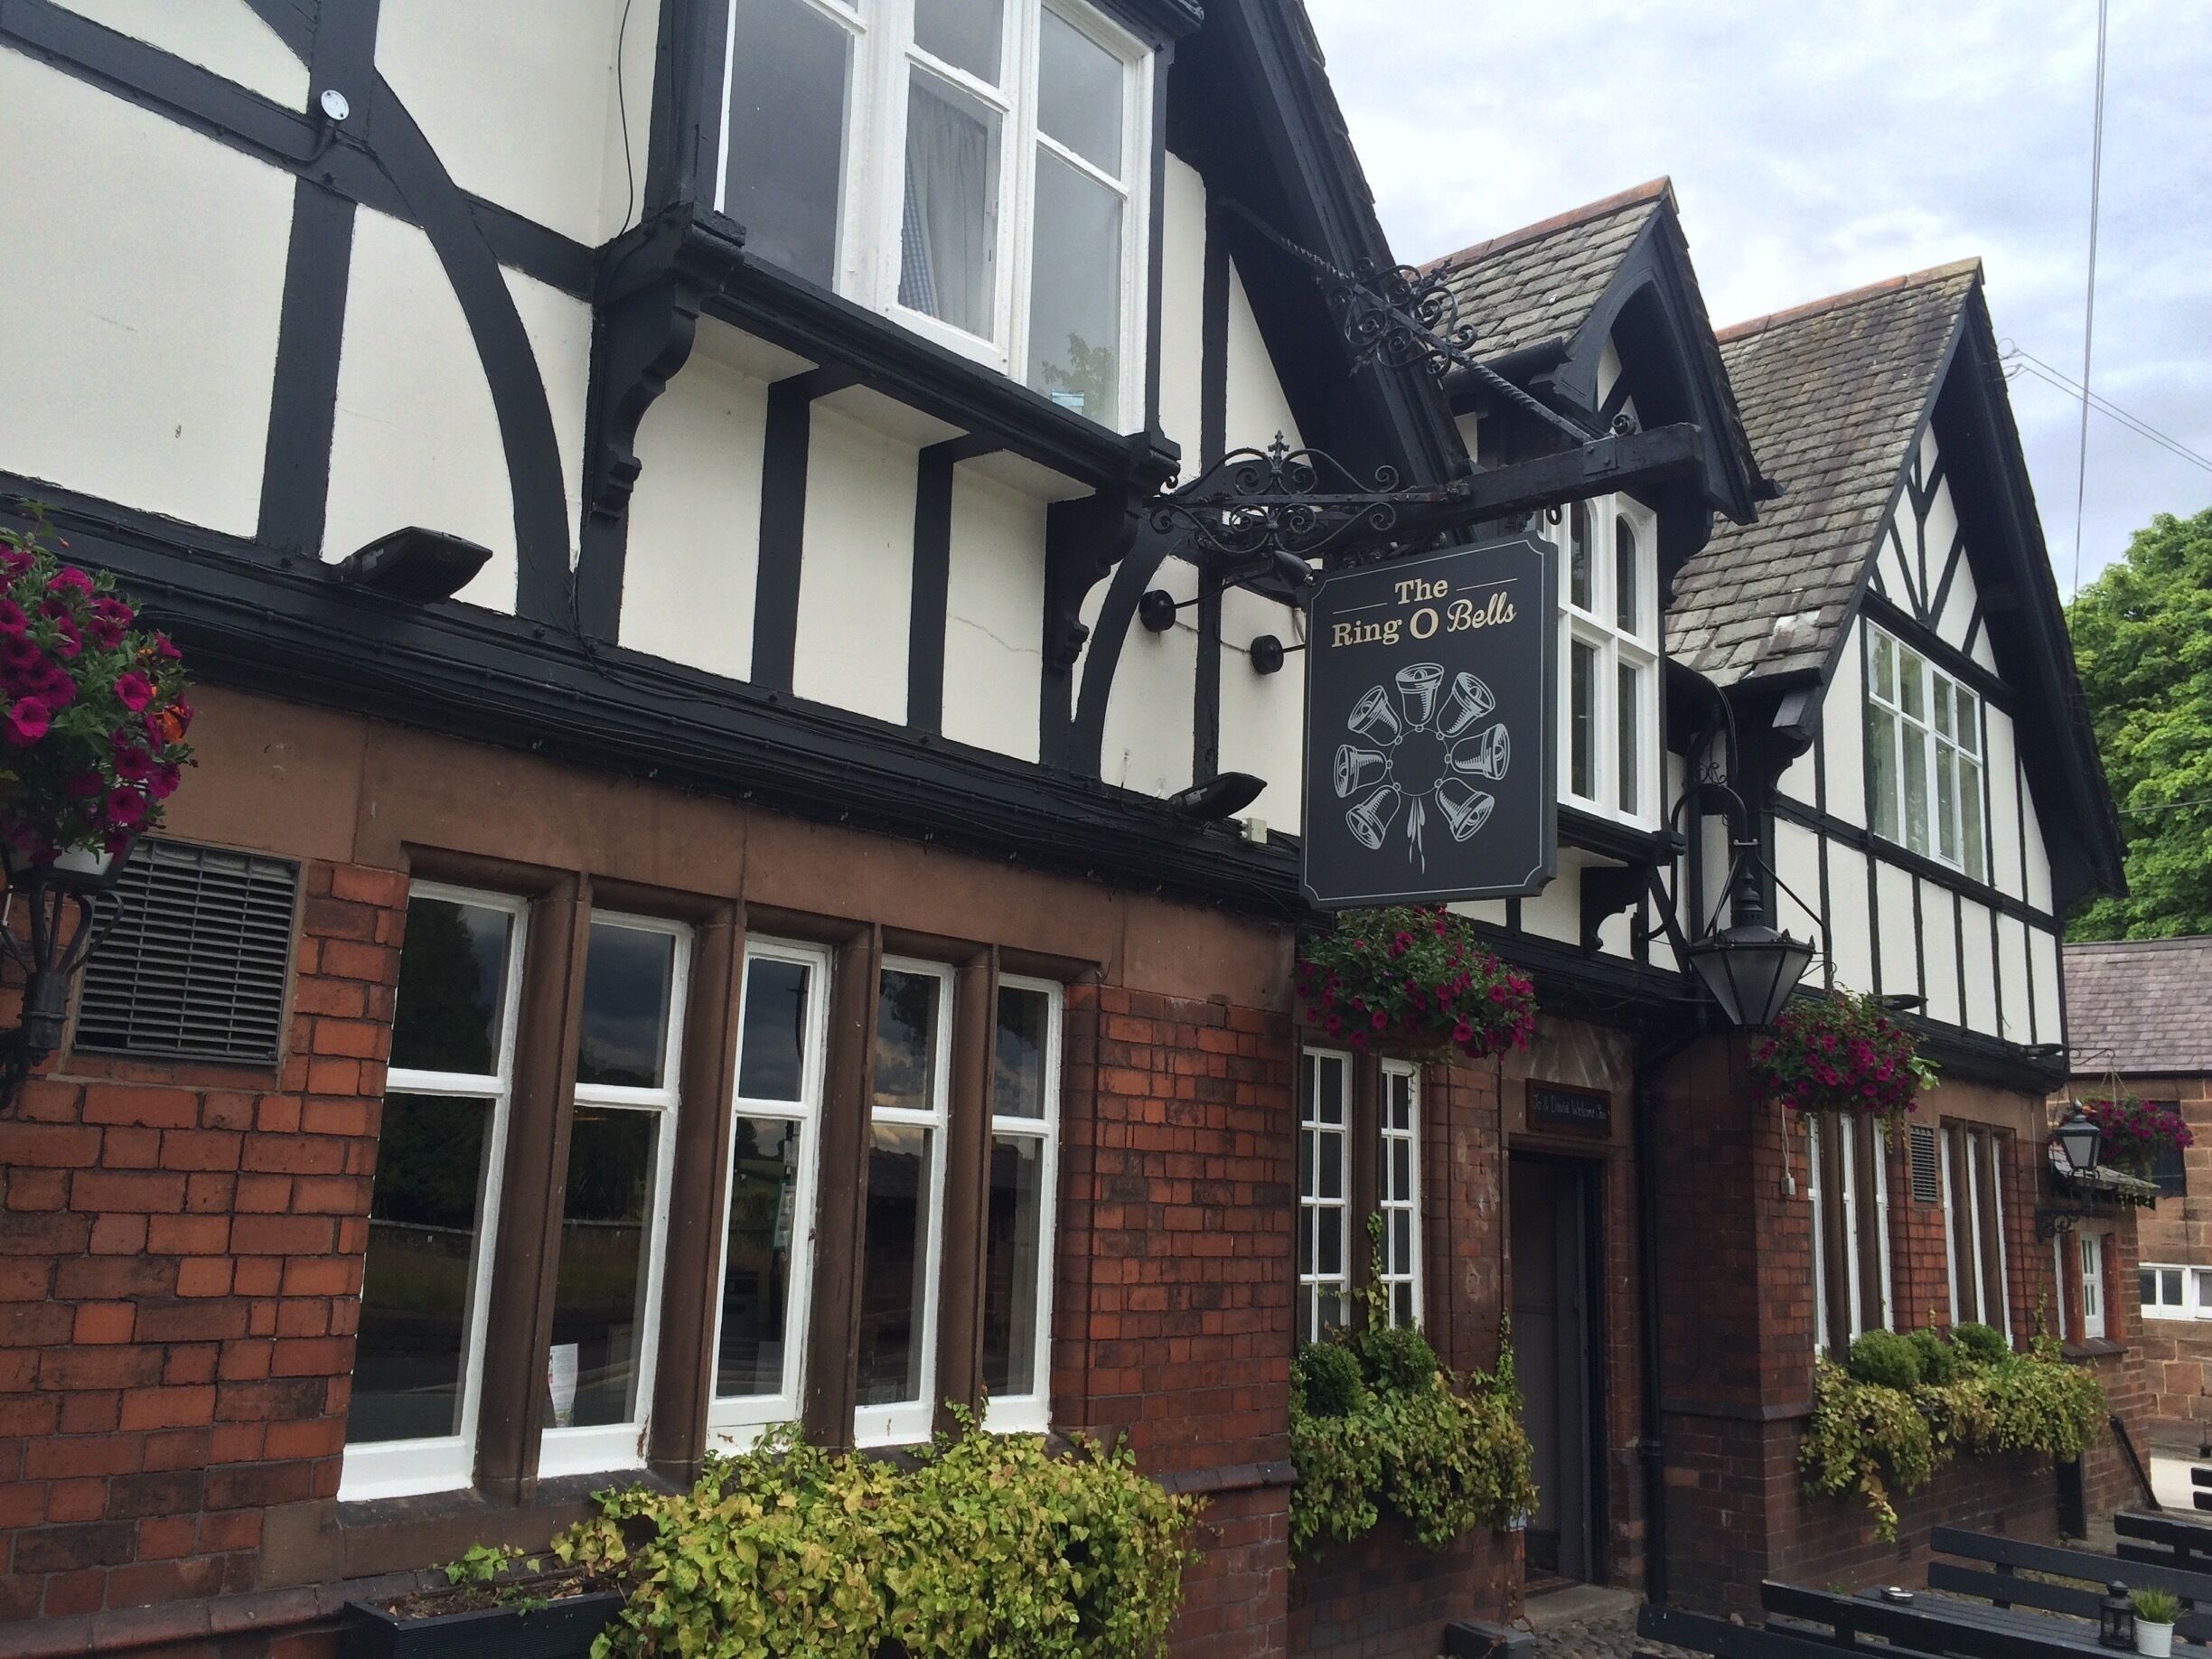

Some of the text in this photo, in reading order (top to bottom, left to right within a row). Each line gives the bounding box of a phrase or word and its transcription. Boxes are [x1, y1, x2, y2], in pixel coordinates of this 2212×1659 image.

[1394, 578, 1448, 605] The
[1331, 591, 1517, 648] Ring O Bells
